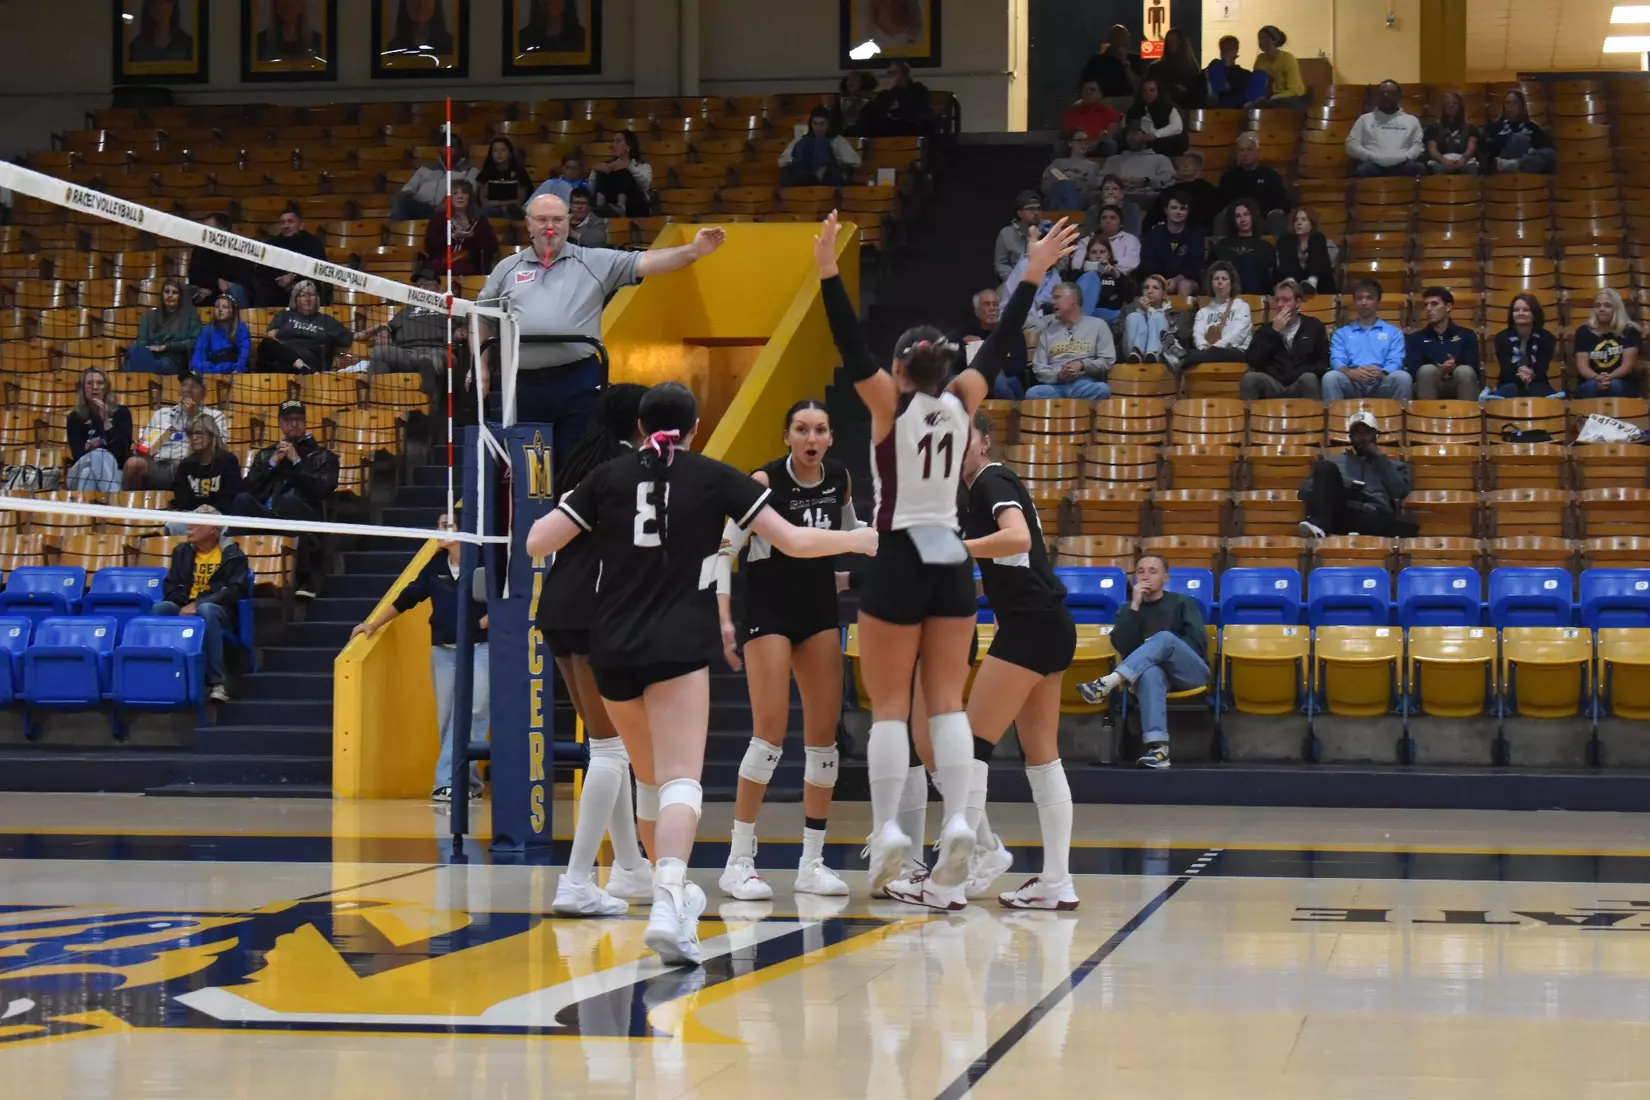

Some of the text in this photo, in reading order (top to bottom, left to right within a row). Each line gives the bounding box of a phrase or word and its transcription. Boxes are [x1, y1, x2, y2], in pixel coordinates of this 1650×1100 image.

[95, 197, 137, 222] VOLLEYBALL
[917, 431, 954, 480] 11
[187, 474, 221, 496] MSU
[802, 507, 832, 531] 14
